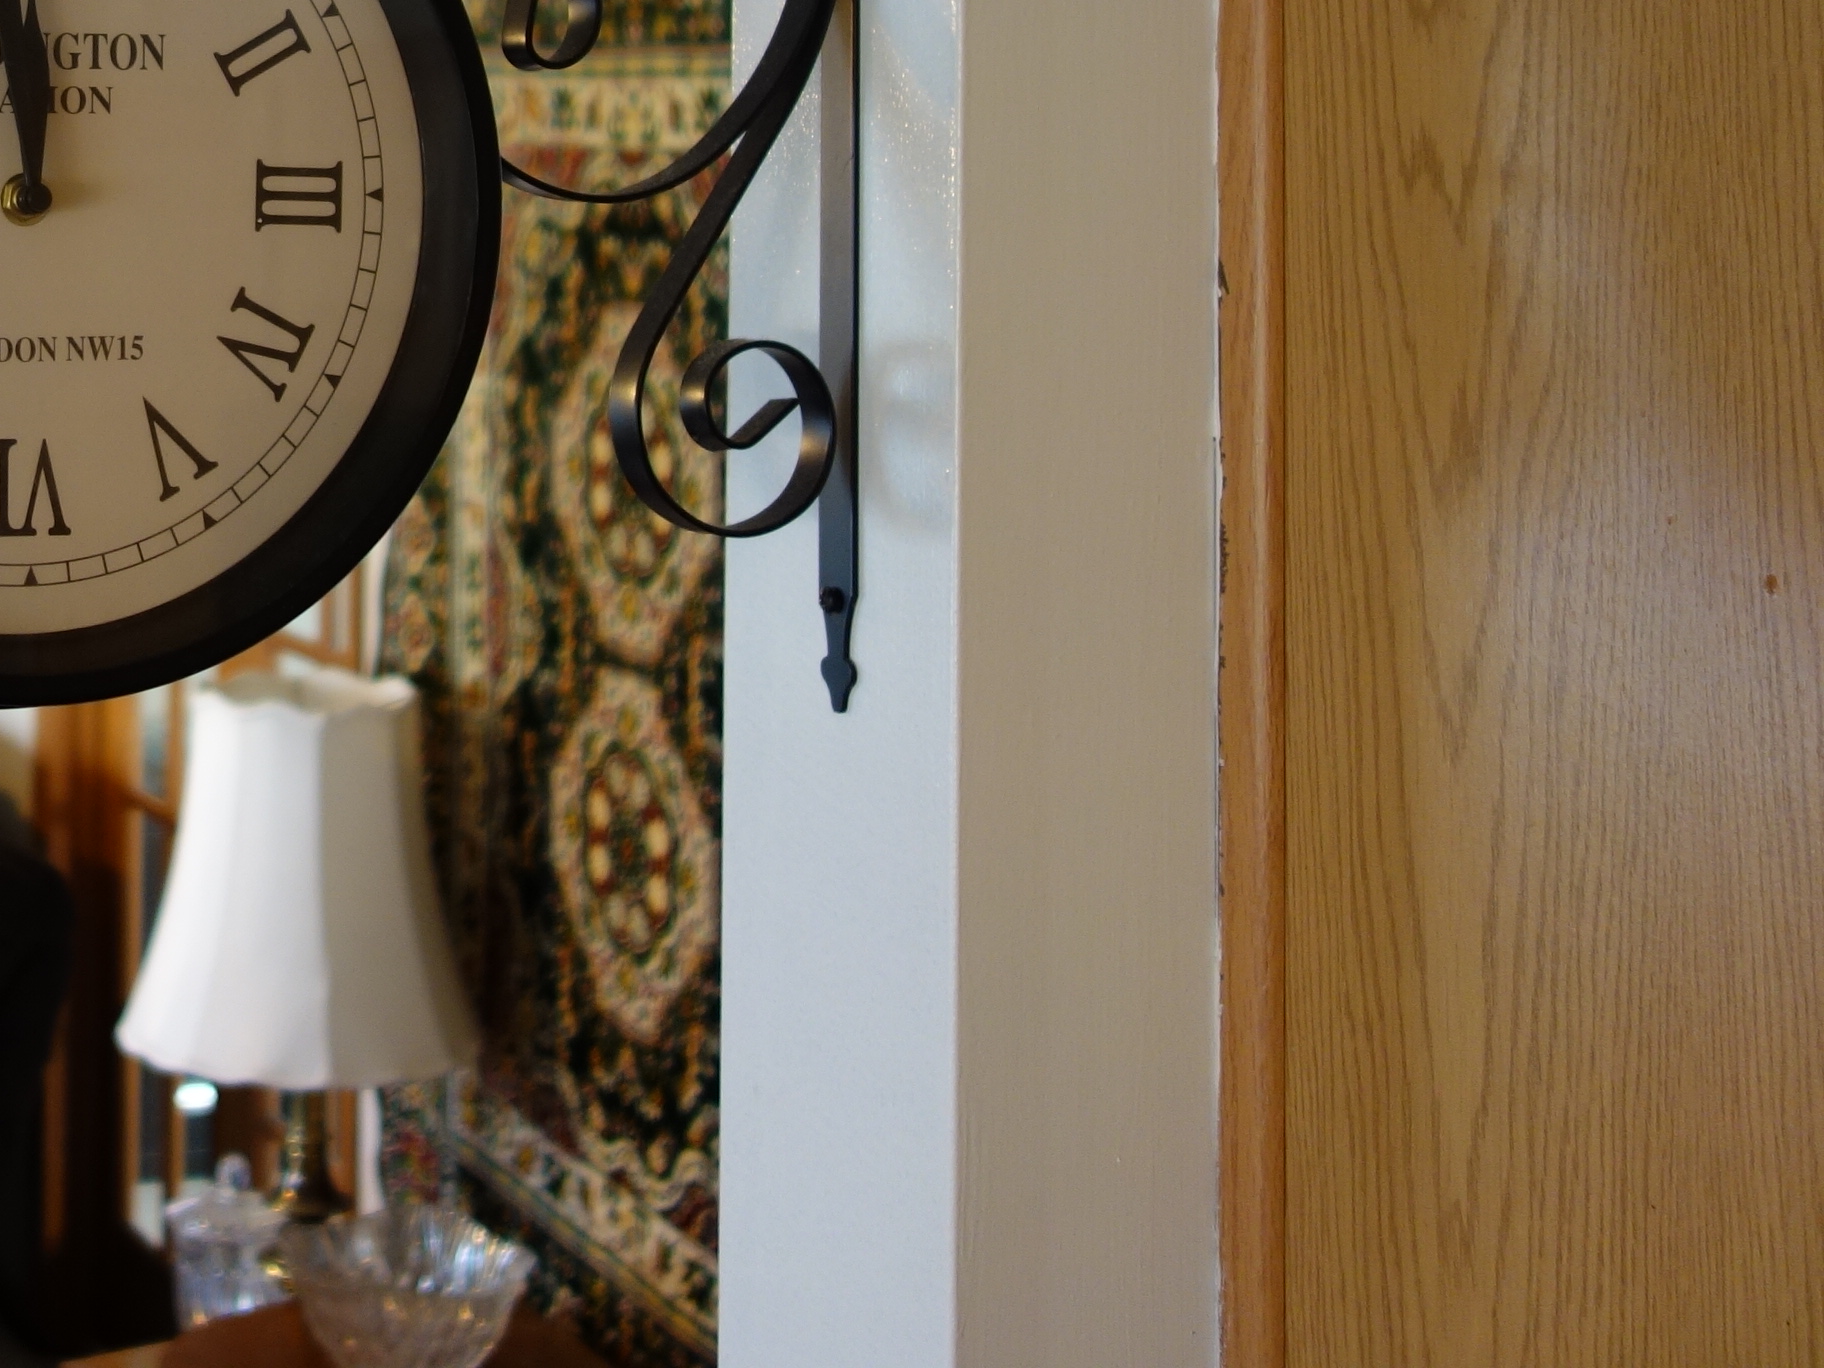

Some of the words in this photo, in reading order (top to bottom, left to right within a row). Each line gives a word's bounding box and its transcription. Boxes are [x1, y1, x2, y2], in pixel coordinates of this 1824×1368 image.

[213, 8, 312, 98] II
[254, 158, 344, 234] III
[66, 334, 145, 362] NW15
[216, 286, 316, 403] IV
[142, 396, 219, 503] V
